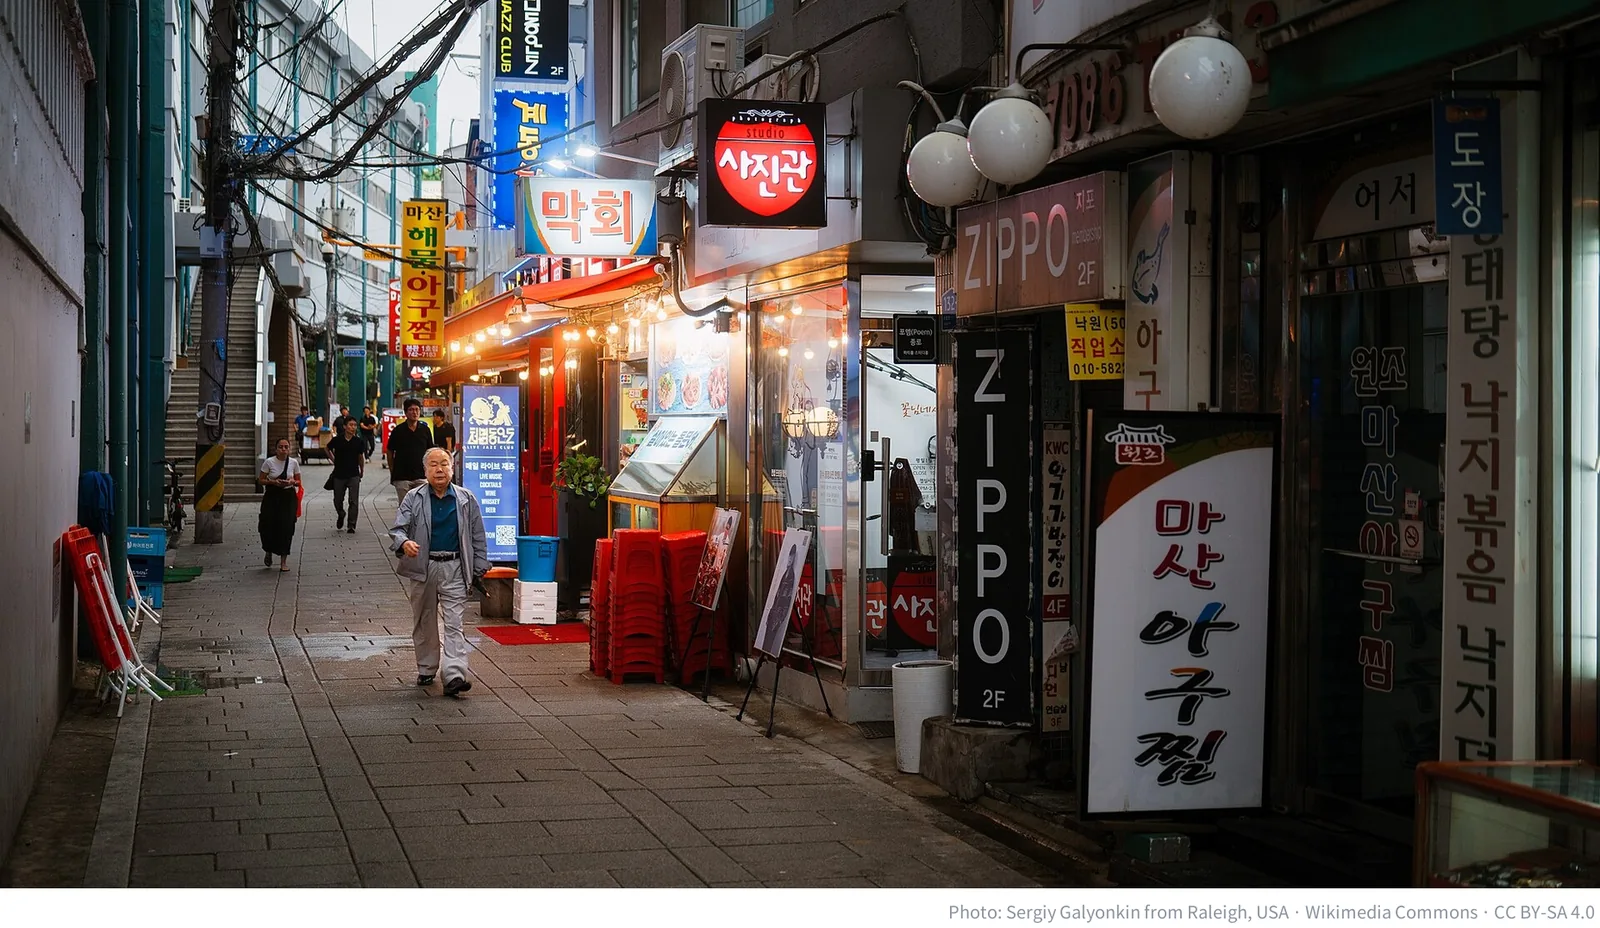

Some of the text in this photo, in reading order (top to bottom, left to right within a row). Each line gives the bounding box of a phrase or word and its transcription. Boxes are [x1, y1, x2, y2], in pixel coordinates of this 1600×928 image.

[500, 36, 512, 73] CLUB
[550, 66, 564, 75] 2F
[731, 115, 801, 124] photograph
[746, 126, 785, 139] studio
[718, 148, 814, 198] 사진관
[1450, 132, 1488, 229] 도장
[1075, 188, 1096, 213] 지포
[1354, 172, 1416, 221] 어서
[405, 205, 443, 221] 마산
[541, 188, 634, 244] 막회
[964, 203, 1070, 290] ZIPPO
[1077, 260, 1097, 287] 2F
[943, 295, 956, 312] 132
[1070, 336, 1125, 359] 직업소
[1045, 441, 1069, 455] KWC
[1121, 445, 1160, 463] 원조
[1456, 380, 1508, 606] 낙지볶음
[972, 348, 1011, 665] ZIPPO
[1350, 345, 1408, 694] 원조 마산 아구찜
[1046, 599, 1067, 615] 4F
[1134, 499, 1240, 787] 마산 아구찜
[982, 690, 1006, 710] 2F
[1050, 717, 1063, 727] 3F
